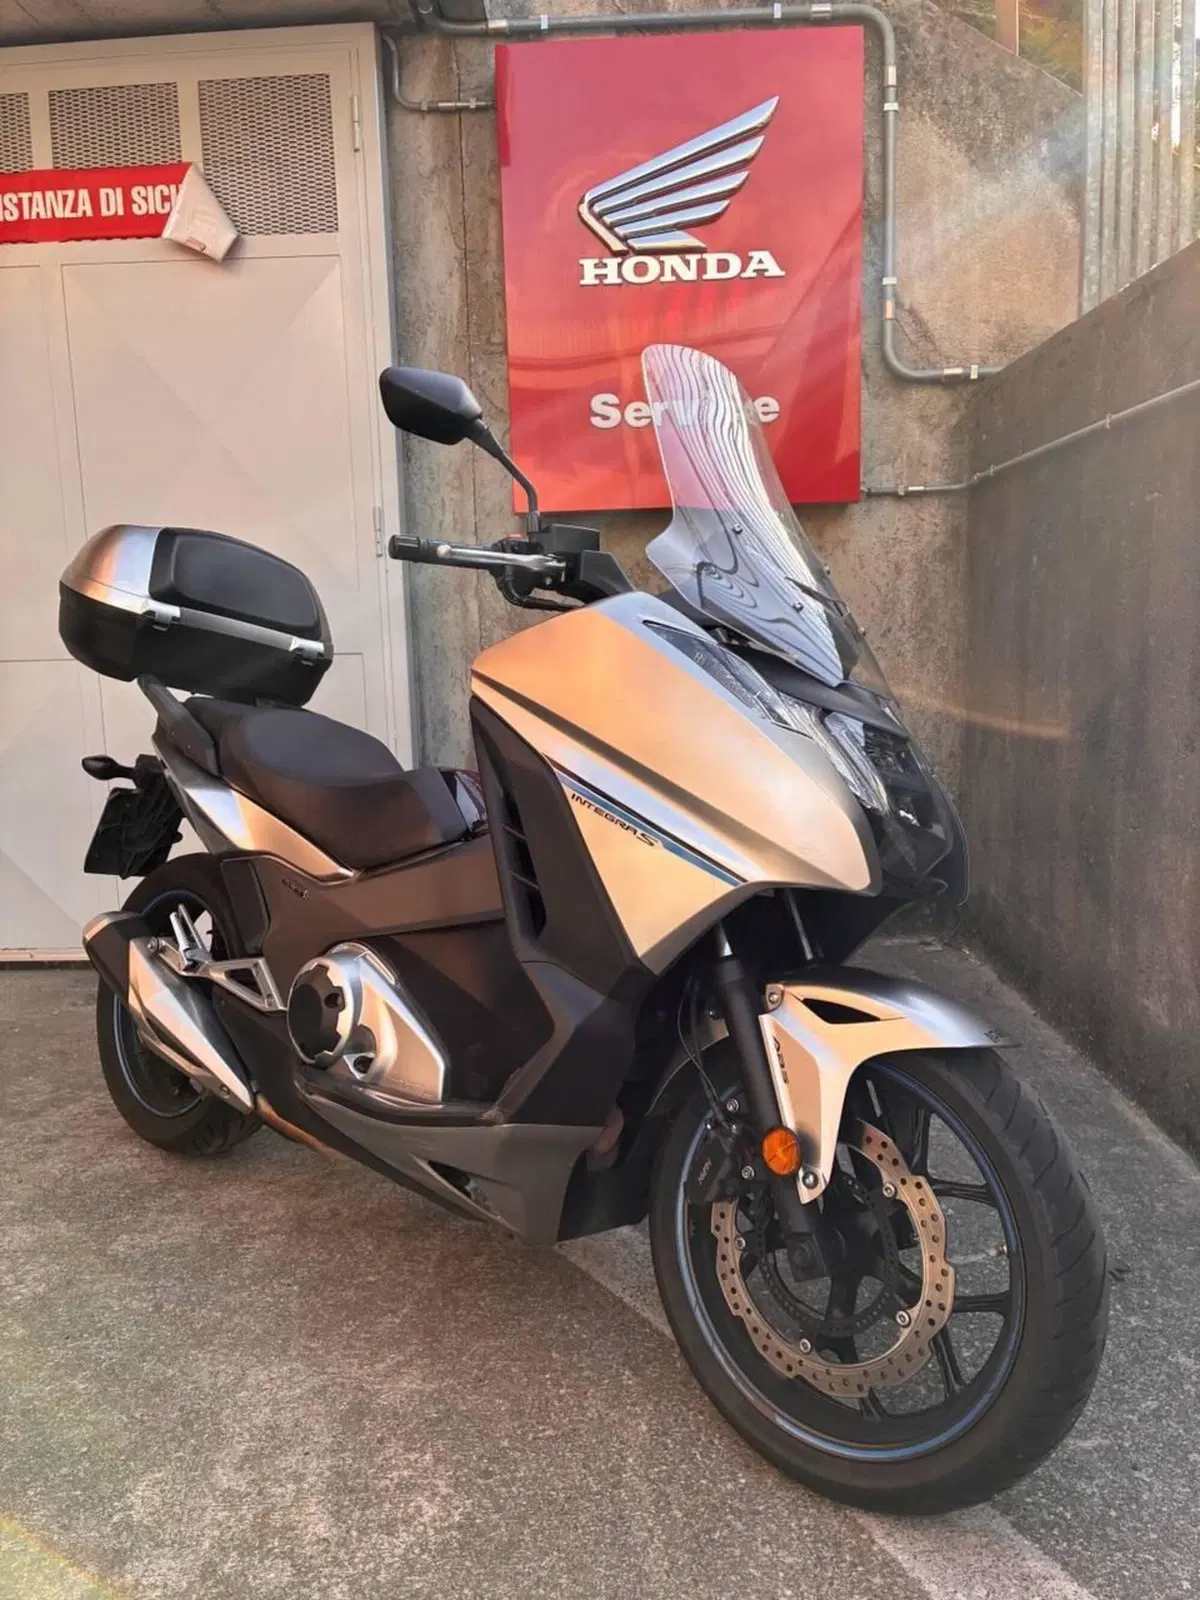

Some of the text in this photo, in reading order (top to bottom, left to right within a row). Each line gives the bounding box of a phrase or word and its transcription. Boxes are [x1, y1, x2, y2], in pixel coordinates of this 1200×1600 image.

[101, 187, 124, 217] DI
[578, 250, 786, 286] HONDA
[571, 792, 638, 836] INTEGRA
